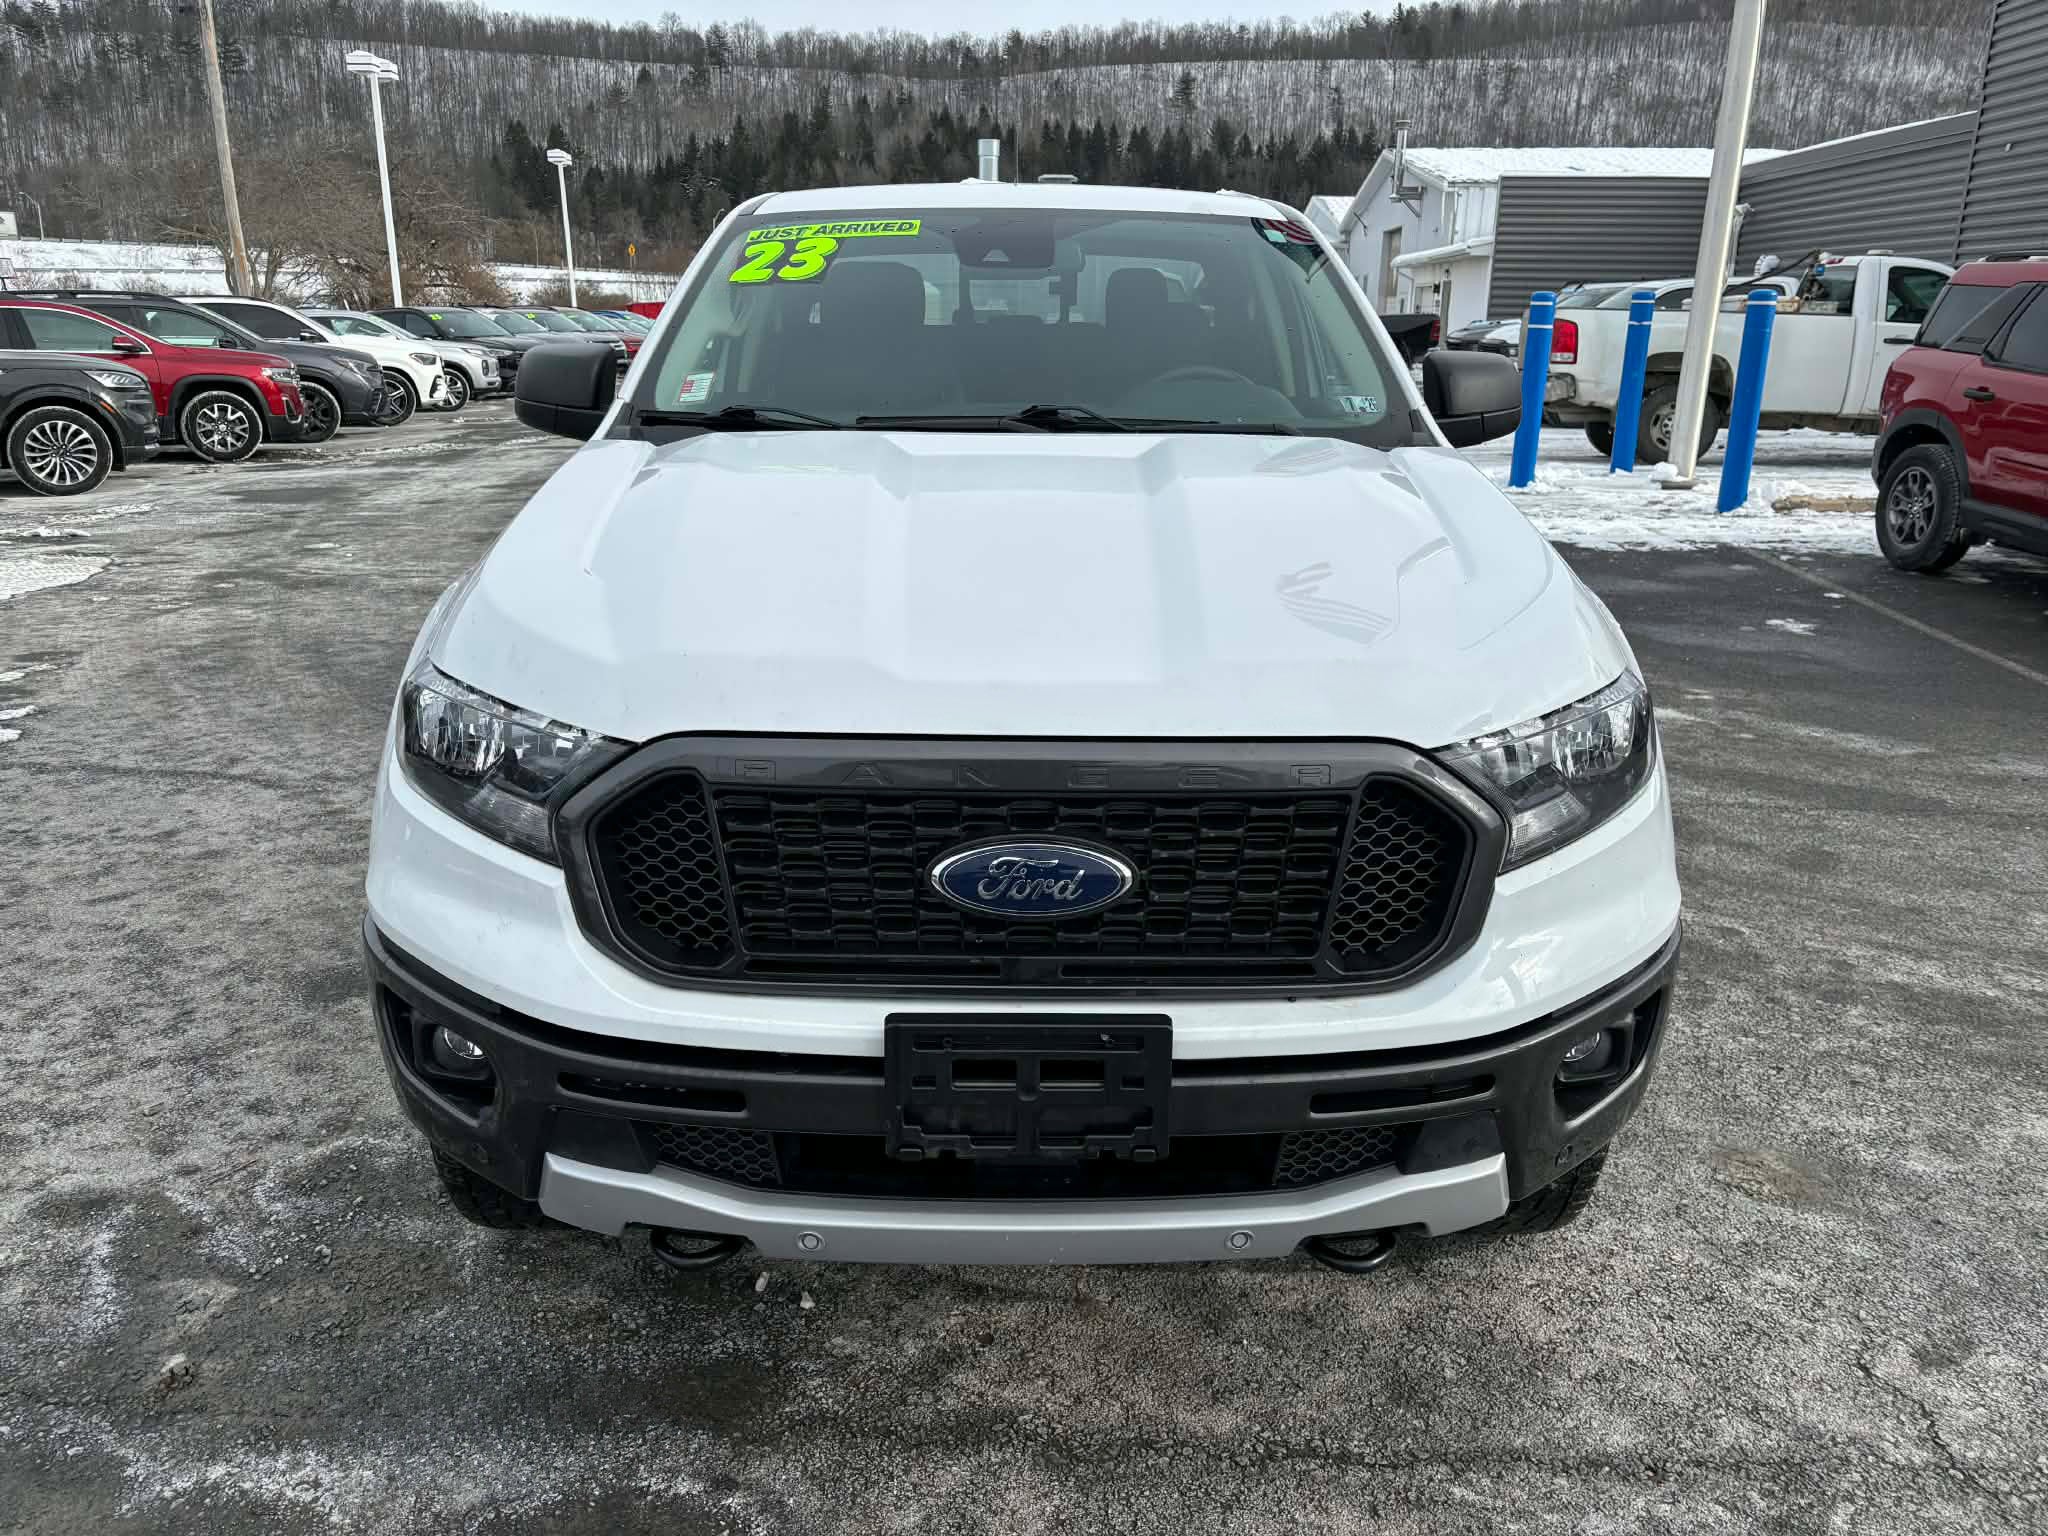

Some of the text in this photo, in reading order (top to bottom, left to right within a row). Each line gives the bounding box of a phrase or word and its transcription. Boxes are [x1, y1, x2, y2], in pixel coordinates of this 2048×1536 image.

[750, 221, 916, 241] JUST ARRIVED
[728, 237, 839, 284] 23
[734, 758, 1333, 788] RANGER
[977, 856, 1086, 900] Ford
